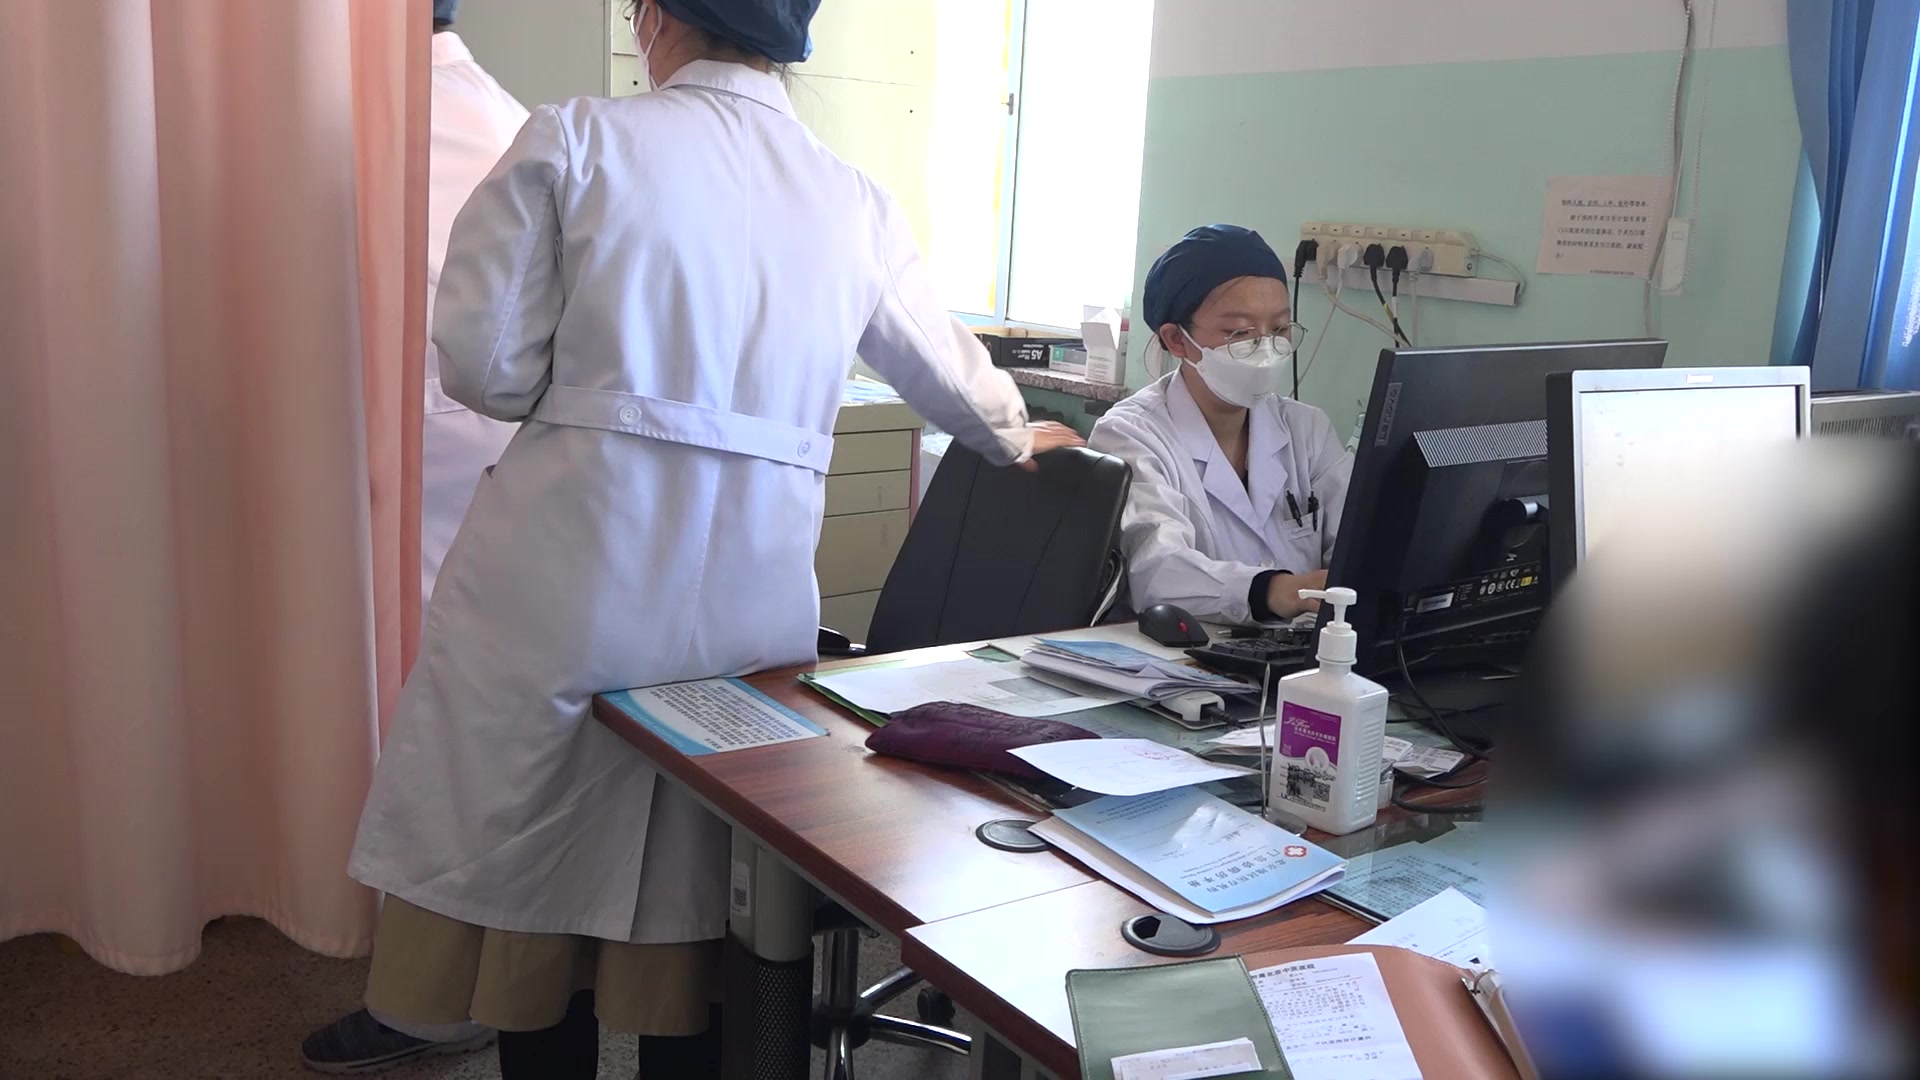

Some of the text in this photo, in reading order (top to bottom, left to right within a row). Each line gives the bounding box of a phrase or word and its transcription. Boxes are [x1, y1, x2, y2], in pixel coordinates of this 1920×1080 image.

[1031, 349, 1043, 360] A5
[1187, 848, 1281, 888] 门急诊病历手册
[1206, 859, 1287, 894] 北京地区医疗机构
